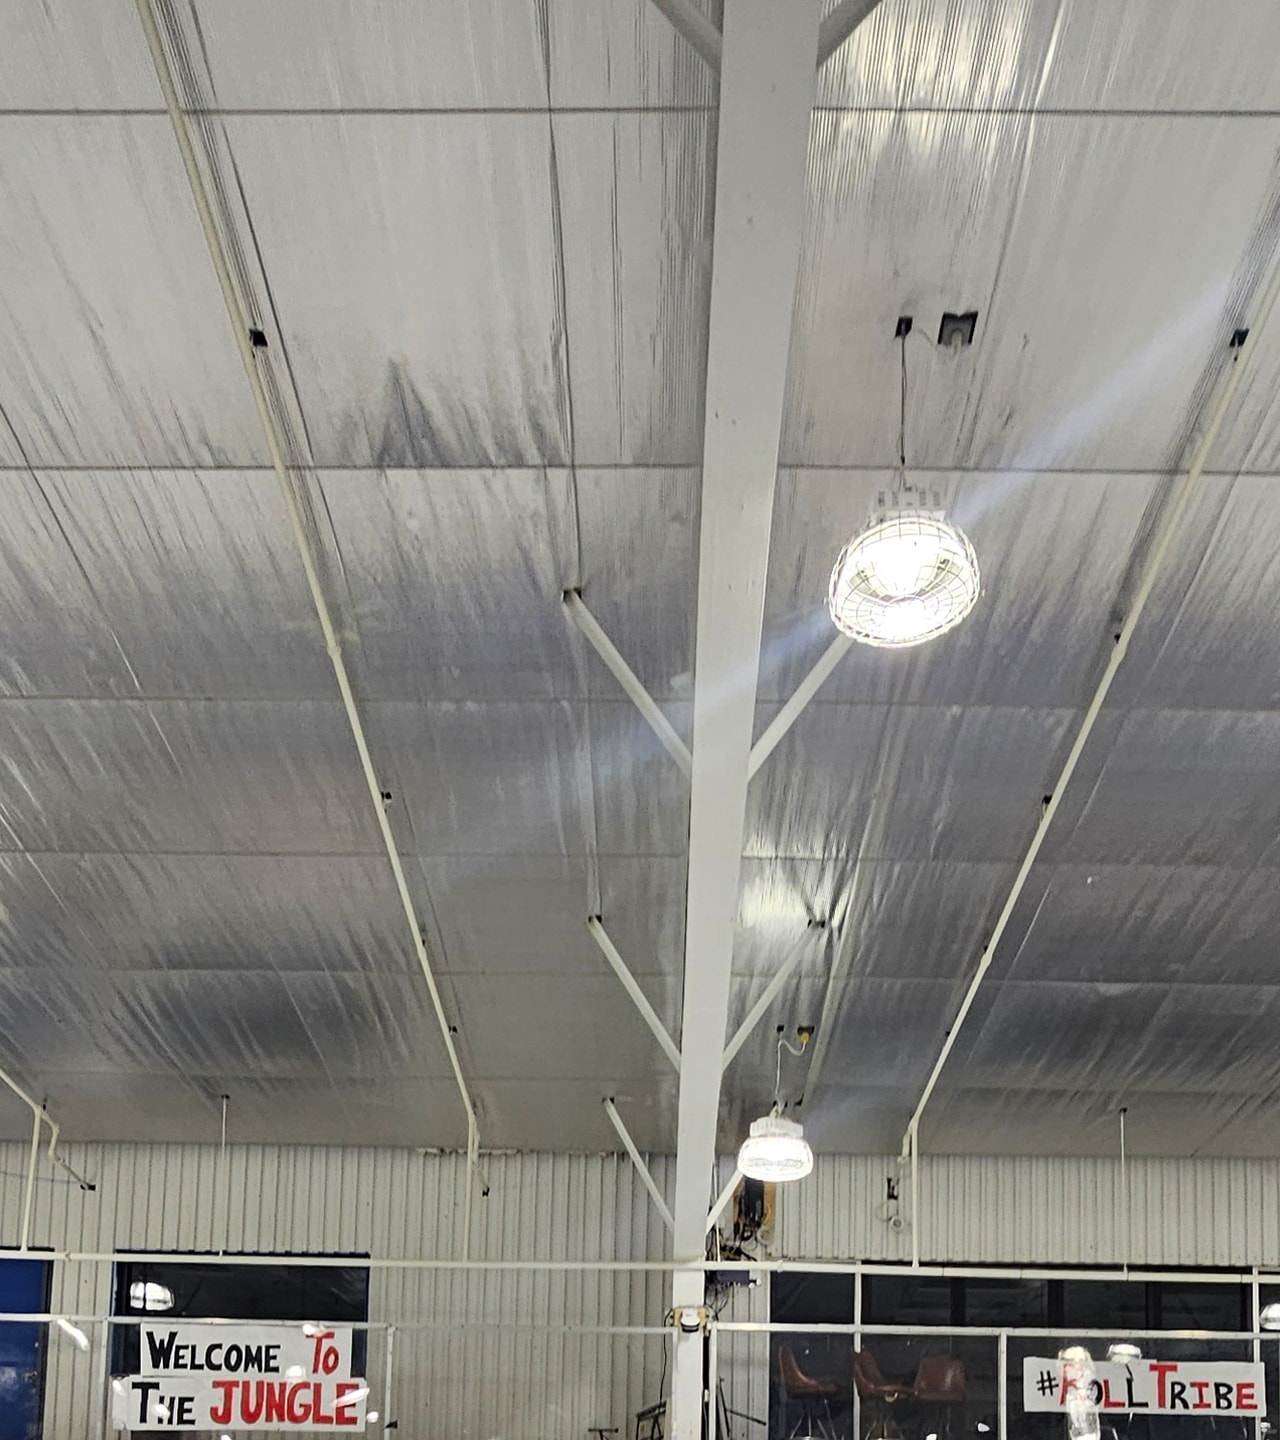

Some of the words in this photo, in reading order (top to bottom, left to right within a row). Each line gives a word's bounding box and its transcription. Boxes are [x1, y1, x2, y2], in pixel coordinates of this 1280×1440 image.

[146, 1331, 281, 1373] WELCOME
[131, 1382, 196, 1426] THE
[209, 1380, 361, 1426] JUNGLE
[1149, 1364, 1258, 1410] TRIBE
